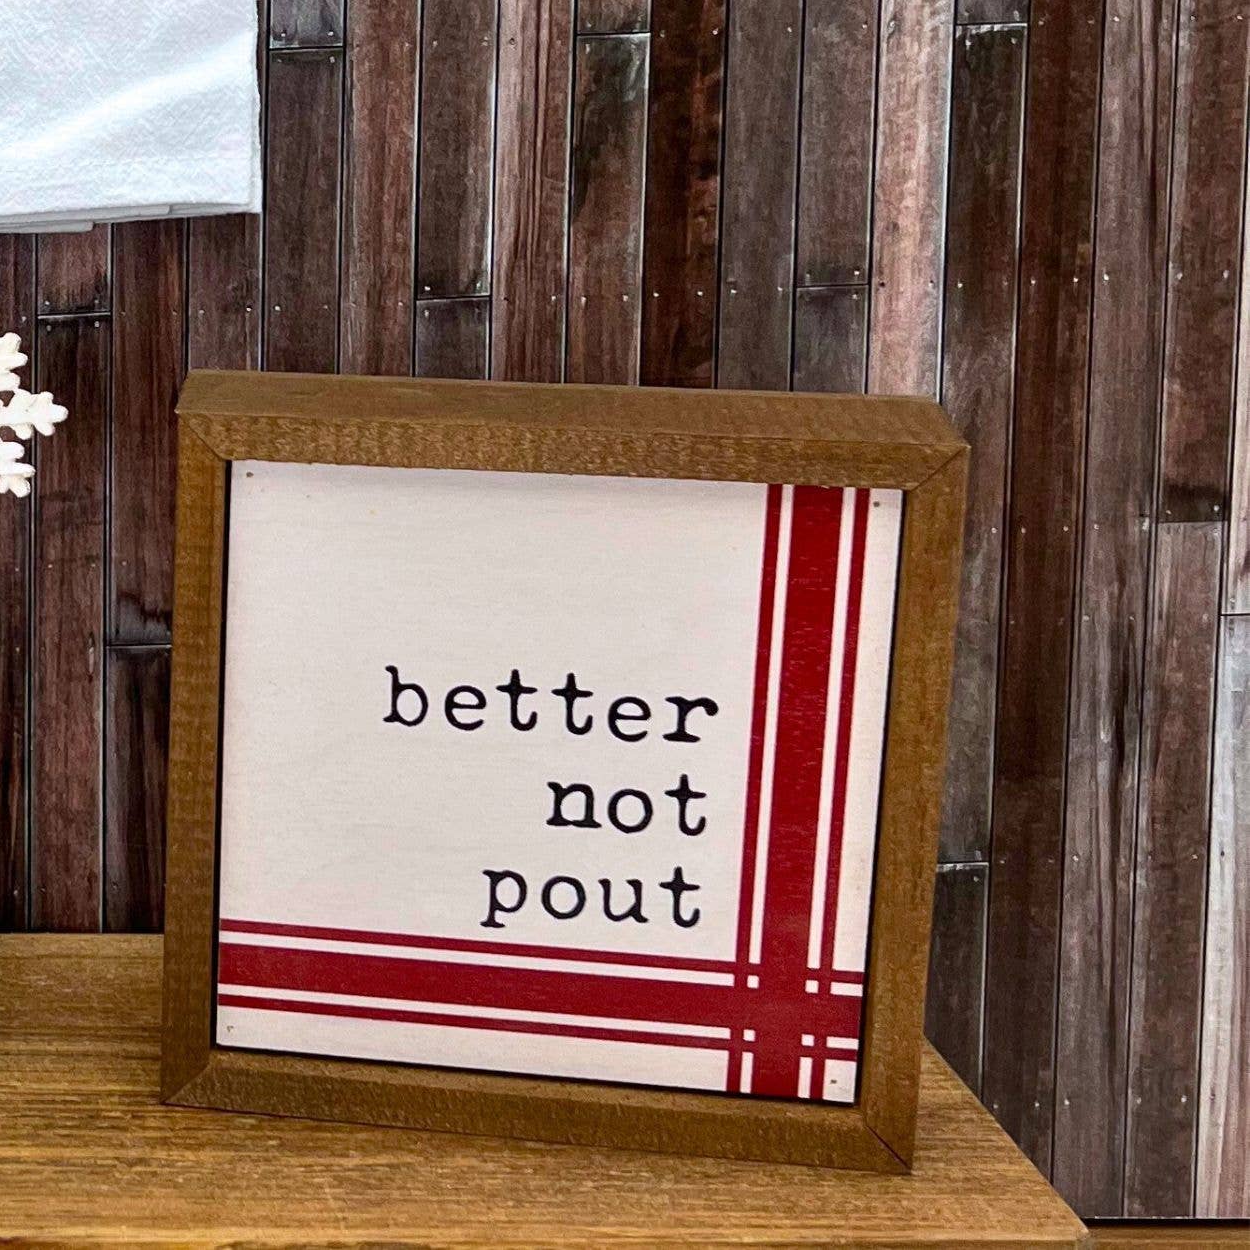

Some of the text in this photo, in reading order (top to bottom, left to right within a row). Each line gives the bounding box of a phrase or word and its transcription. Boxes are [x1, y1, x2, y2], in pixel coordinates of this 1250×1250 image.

[382, 664, 720, 744] better
[545, 773, 708, 837] not
[479, 865, 702, 929] pout
